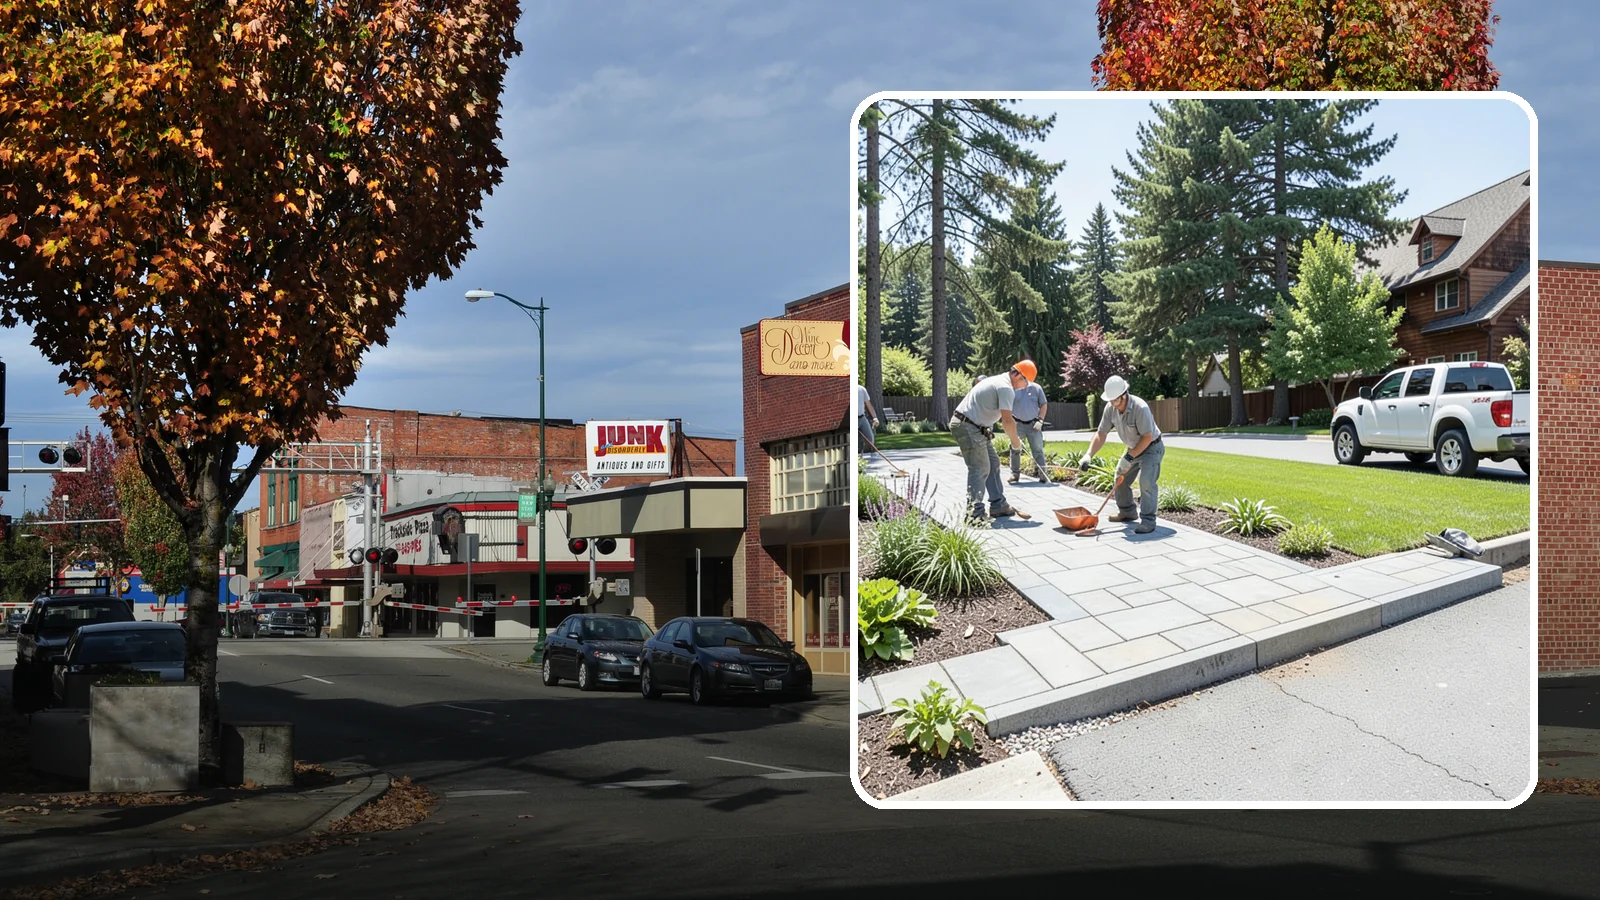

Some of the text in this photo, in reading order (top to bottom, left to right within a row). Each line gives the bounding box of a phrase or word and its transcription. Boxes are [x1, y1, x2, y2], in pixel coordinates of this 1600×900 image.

[765, 328, 831, 365] Decor
[595, 425, 665, 457] JUNK
[607, 446, 646, 454] DISORDERLY
[597, 460, 666, 470] ANTIQUES AND GIFTS
[573, 473, 589, 492] RAIL
[352, 498, 365, 511] CRO
[414, 519, 429, 535] Pizza
